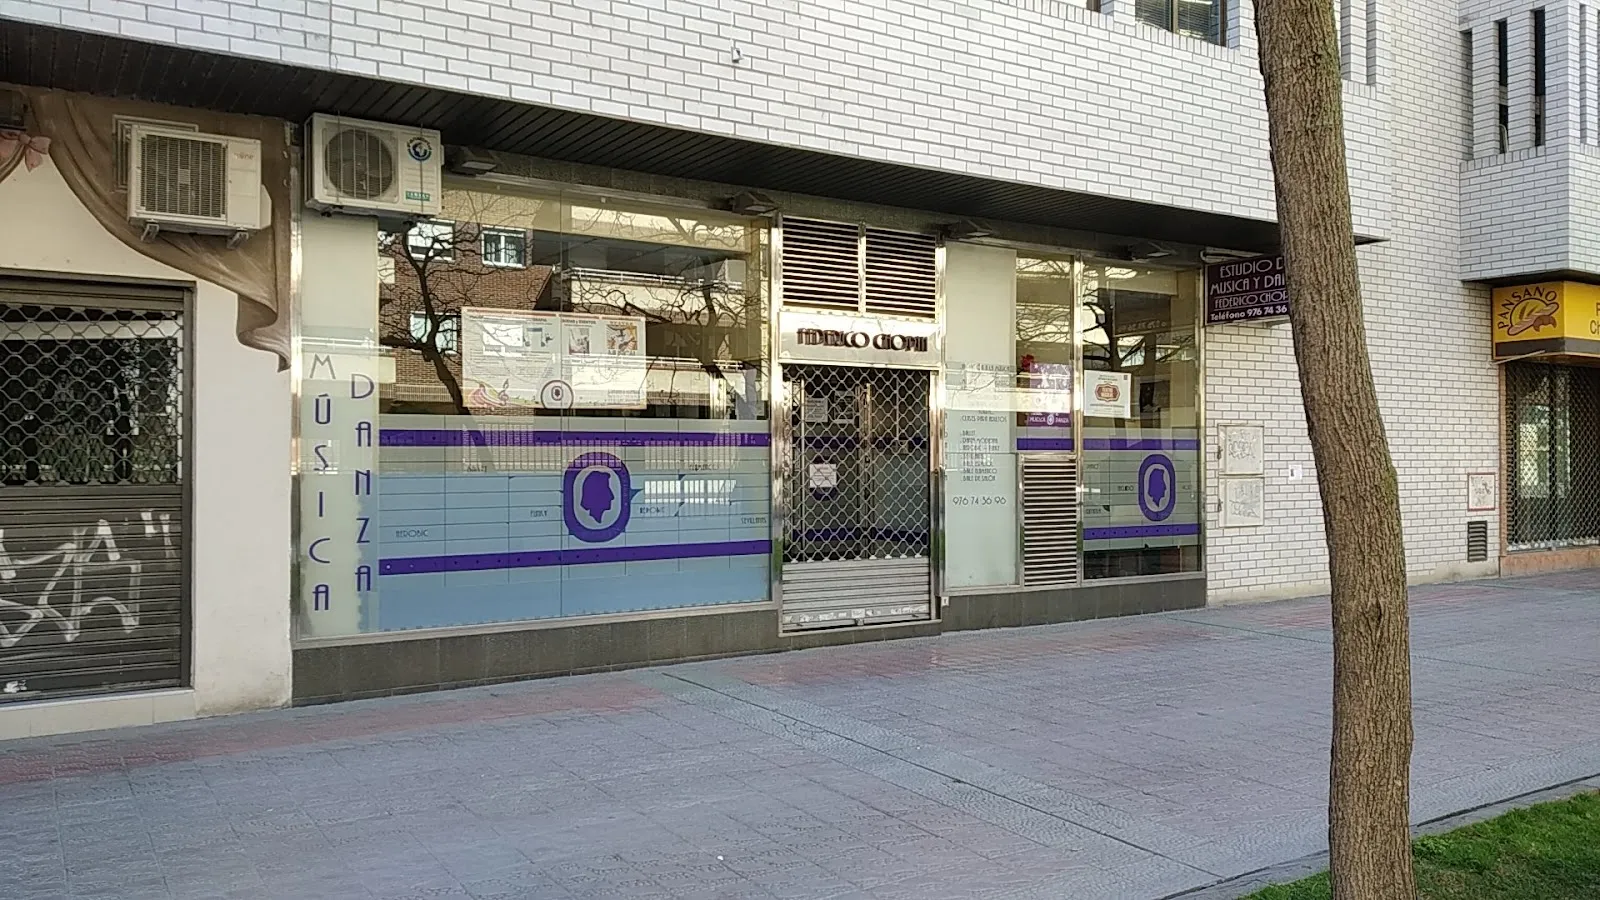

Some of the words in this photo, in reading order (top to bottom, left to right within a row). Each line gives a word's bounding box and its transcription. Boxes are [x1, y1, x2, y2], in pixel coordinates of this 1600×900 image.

[1220, 259, 1273, 278] ESTUDIO
[1209, 278, 1250, 295] MUSICA
[1253, 277, 1260, 290] Y
[1215, 294, 1258, 309] FEDERICO
[1210, 311, 1245, 321] Teléfono
[1247, 308, 1262, 317] 976
[1263, 306, 1274, 315] 74
[1275, 305, 1287, 314] 36
[796, 327, 870, 349] FEDERICO
[308, 353, 336, 611] MÚSICA
[350, 373, 375, 591] DANZA
[952, 496, 969, 506] 976
[970, 496, 979, 505] 74
[994, 496, 1007, 505] 96
